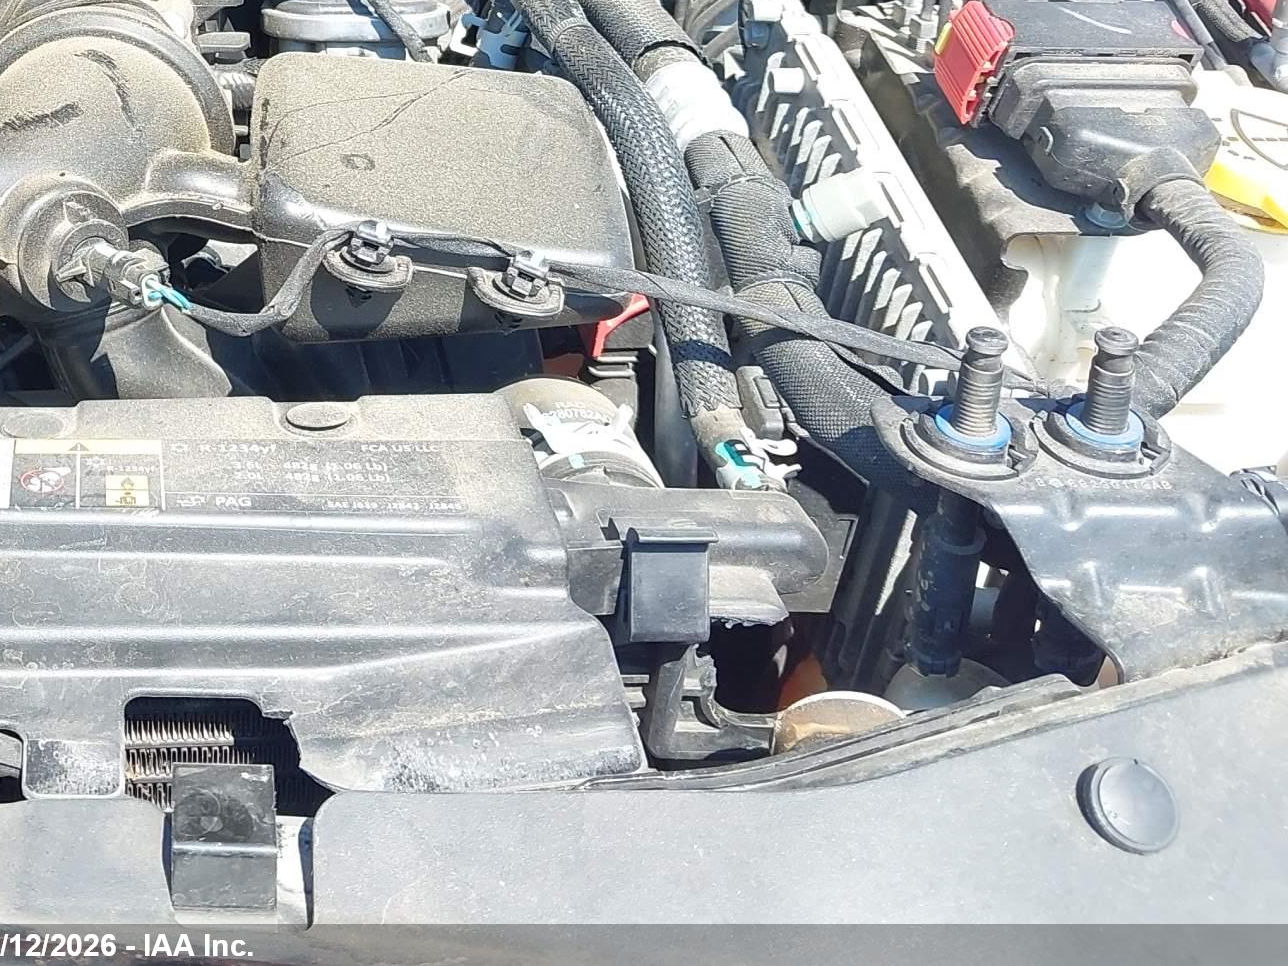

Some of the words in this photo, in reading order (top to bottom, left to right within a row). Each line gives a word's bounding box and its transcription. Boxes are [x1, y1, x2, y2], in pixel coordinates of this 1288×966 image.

[200, 442, 277, 454] R-1234yf
[361, 444, 389, 453] FCA
[392, 444, 412, 453] US
[214, 496, 253, 508] PAG
